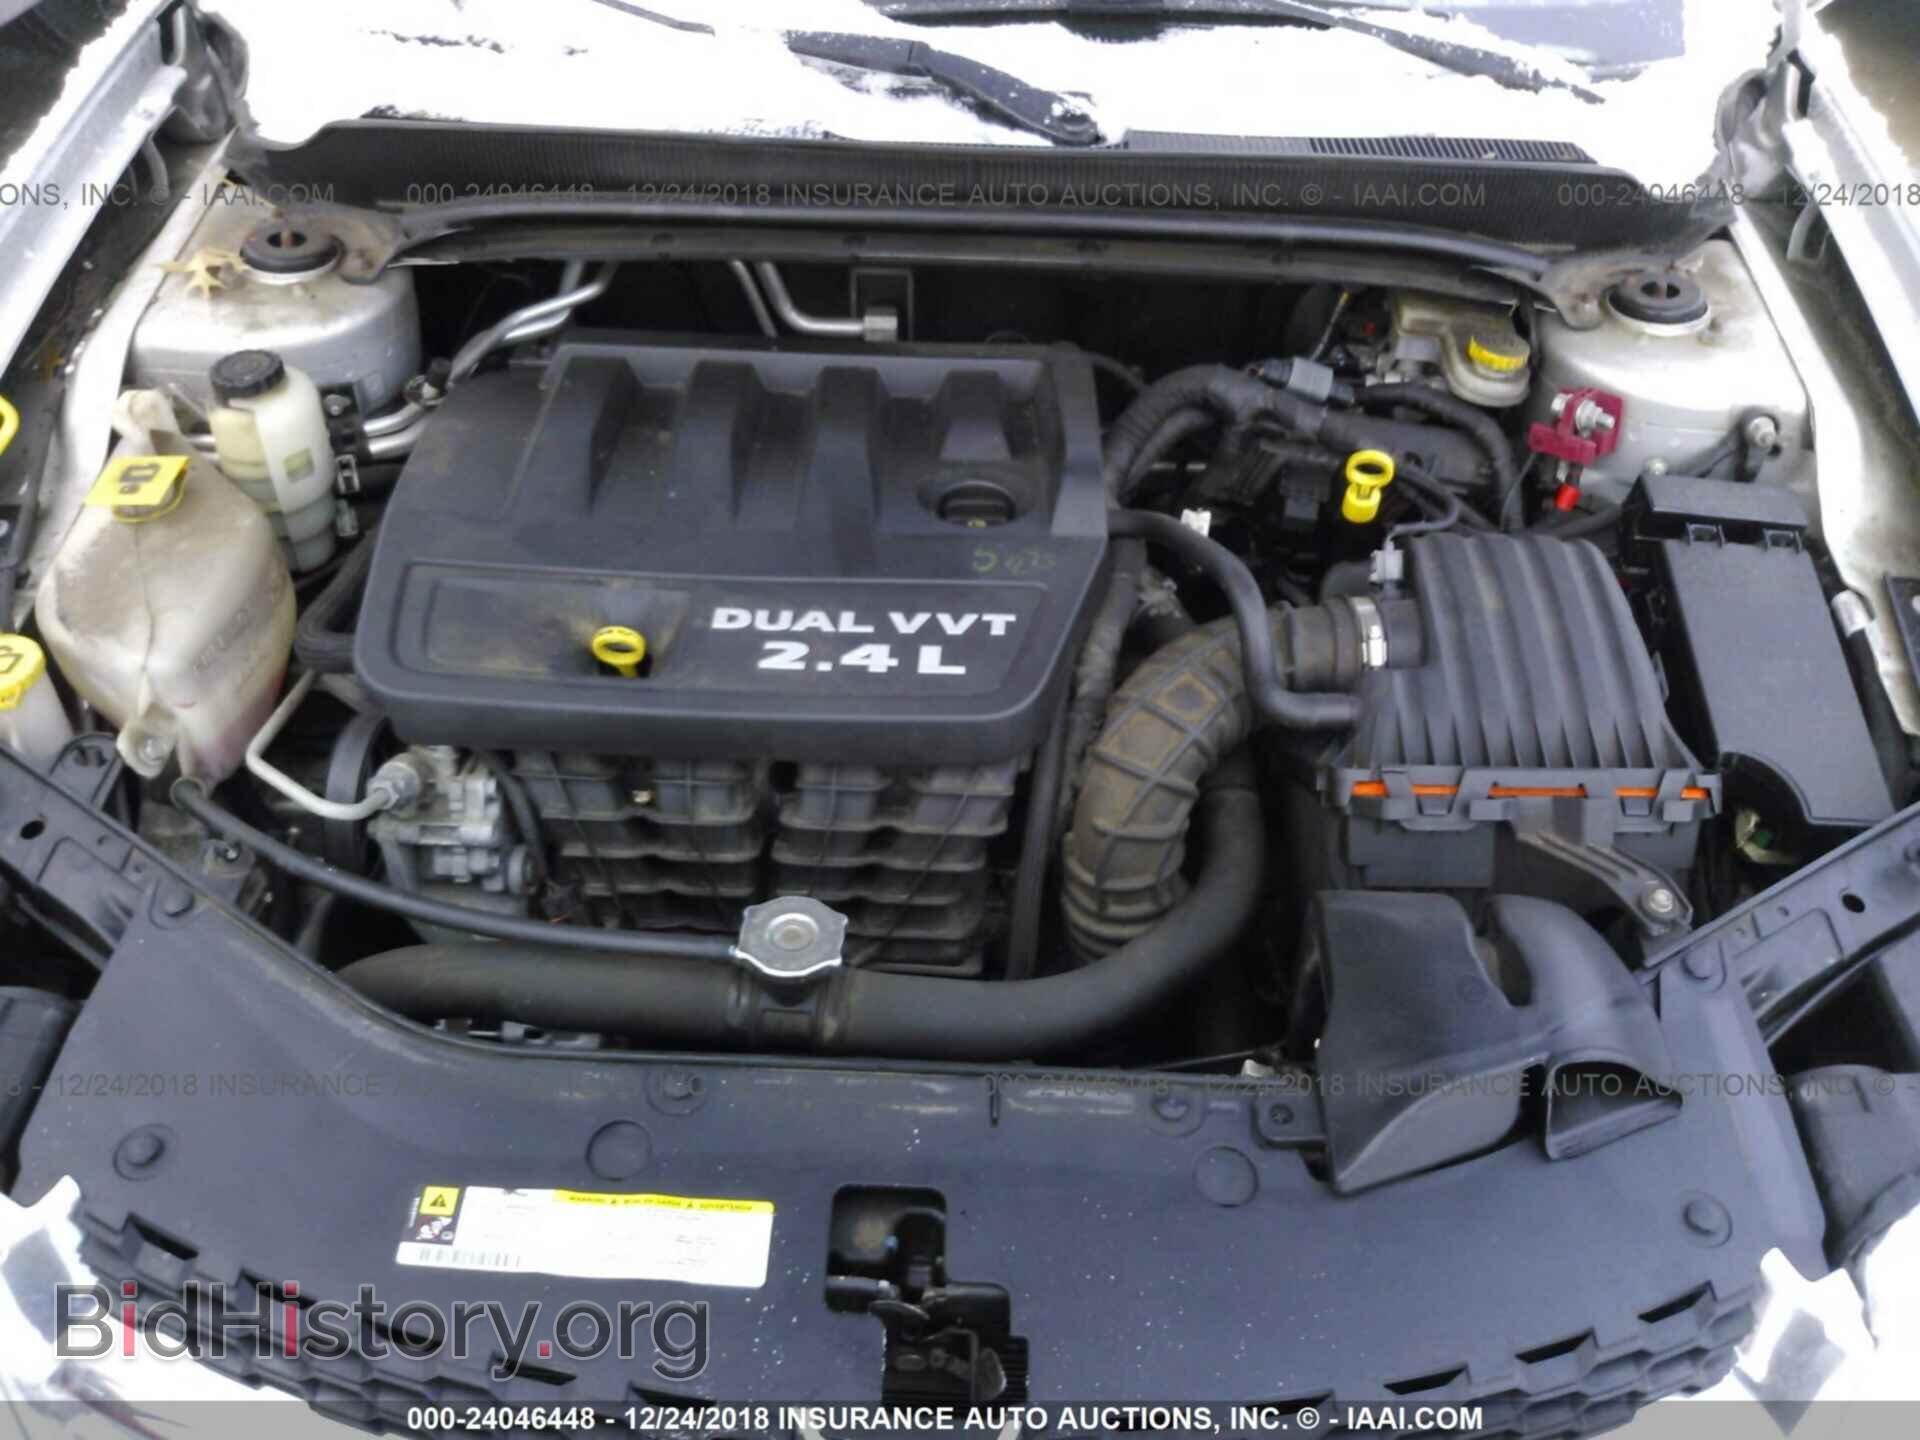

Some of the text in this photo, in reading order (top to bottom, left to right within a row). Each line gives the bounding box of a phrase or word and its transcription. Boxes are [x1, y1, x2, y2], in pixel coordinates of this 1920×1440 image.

[711, 607, 1017, 636] DUAL VVT
[757, 640, 967, 674] 2.4 L
